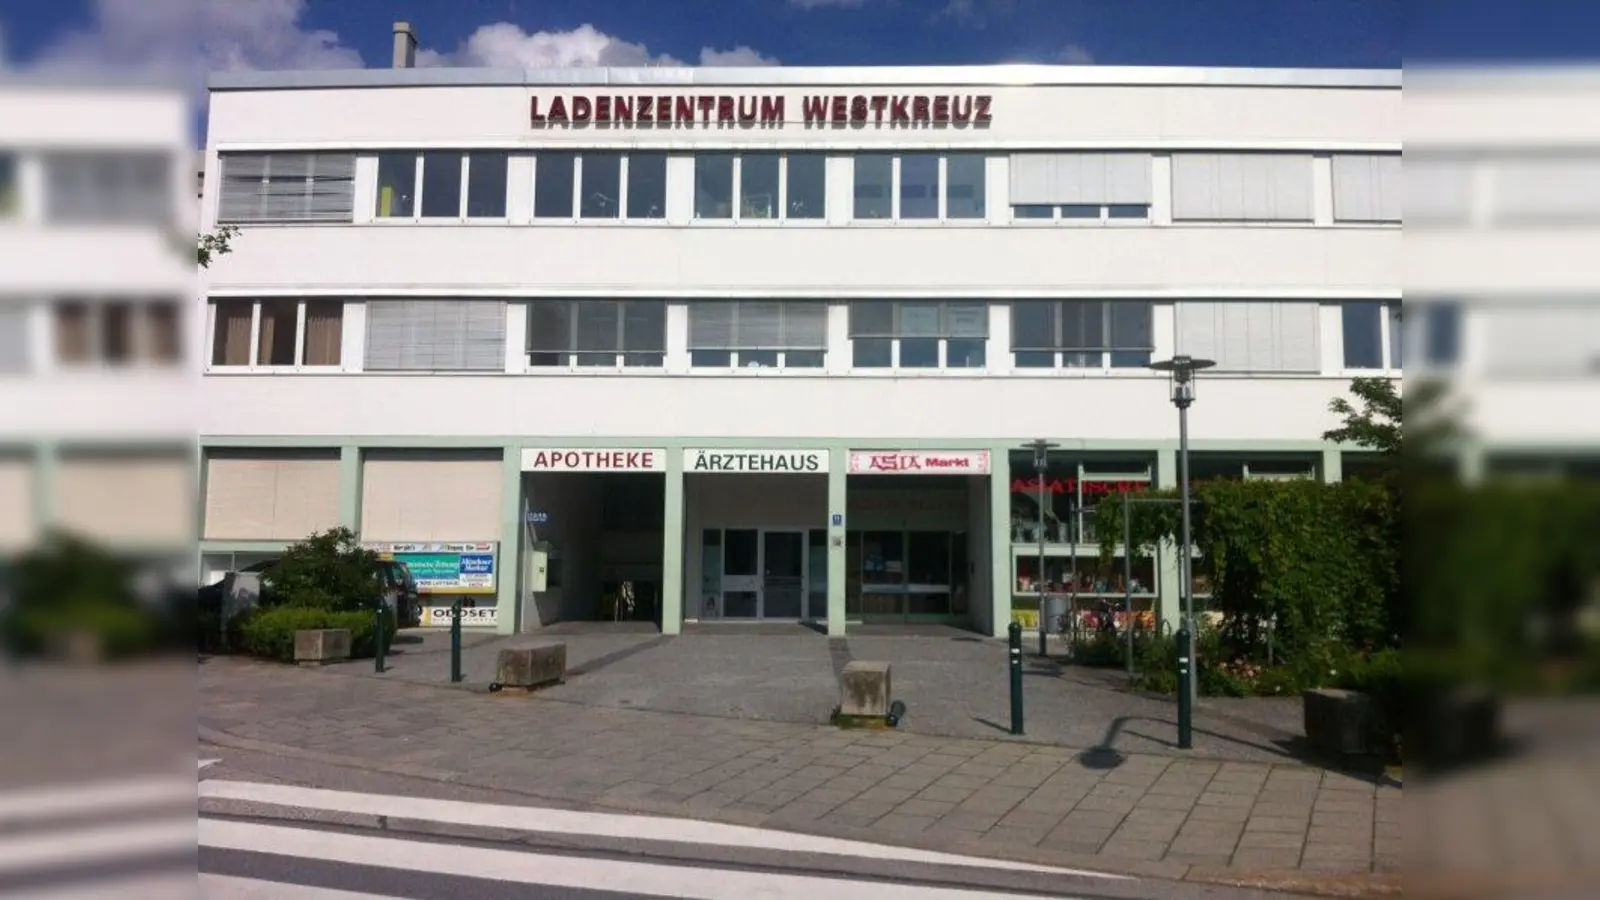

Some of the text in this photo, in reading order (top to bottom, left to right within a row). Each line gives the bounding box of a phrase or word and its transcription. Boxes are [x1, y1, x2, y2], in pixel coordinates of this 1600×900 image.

[529, 96, 993, 124] LADENZENTRUM WESTKREUZ
[533, 452, 654, 469] APOTHEKE
[694, 450, 819, 471] ÄRZTEHAUS
[868, 454, 969, 470] ASIA Markt
